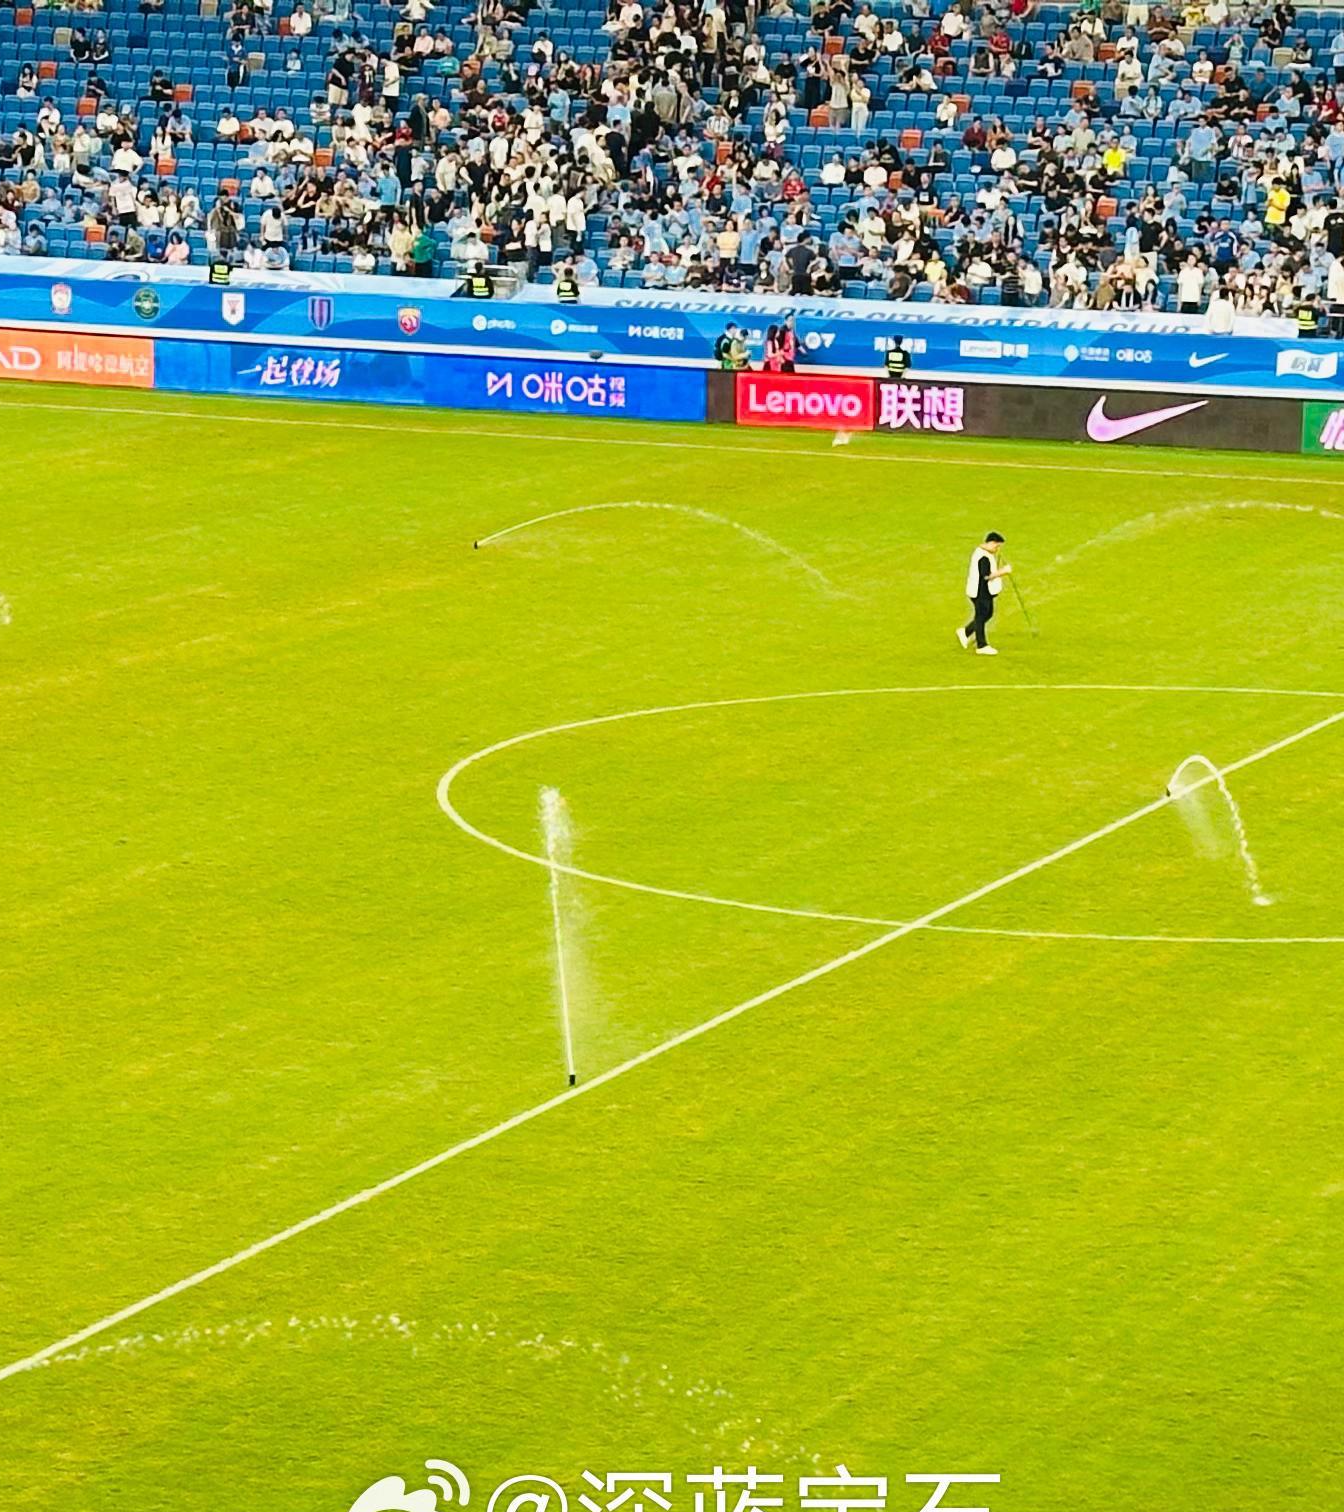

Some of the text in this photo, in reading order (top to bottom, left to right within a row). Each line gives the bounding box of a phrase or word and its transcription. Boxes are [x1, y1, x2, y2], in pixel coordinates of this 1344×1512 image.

[236, 355, 342, 388] 一起登场
[748, 383, 965, 431] Lenovo 联想
